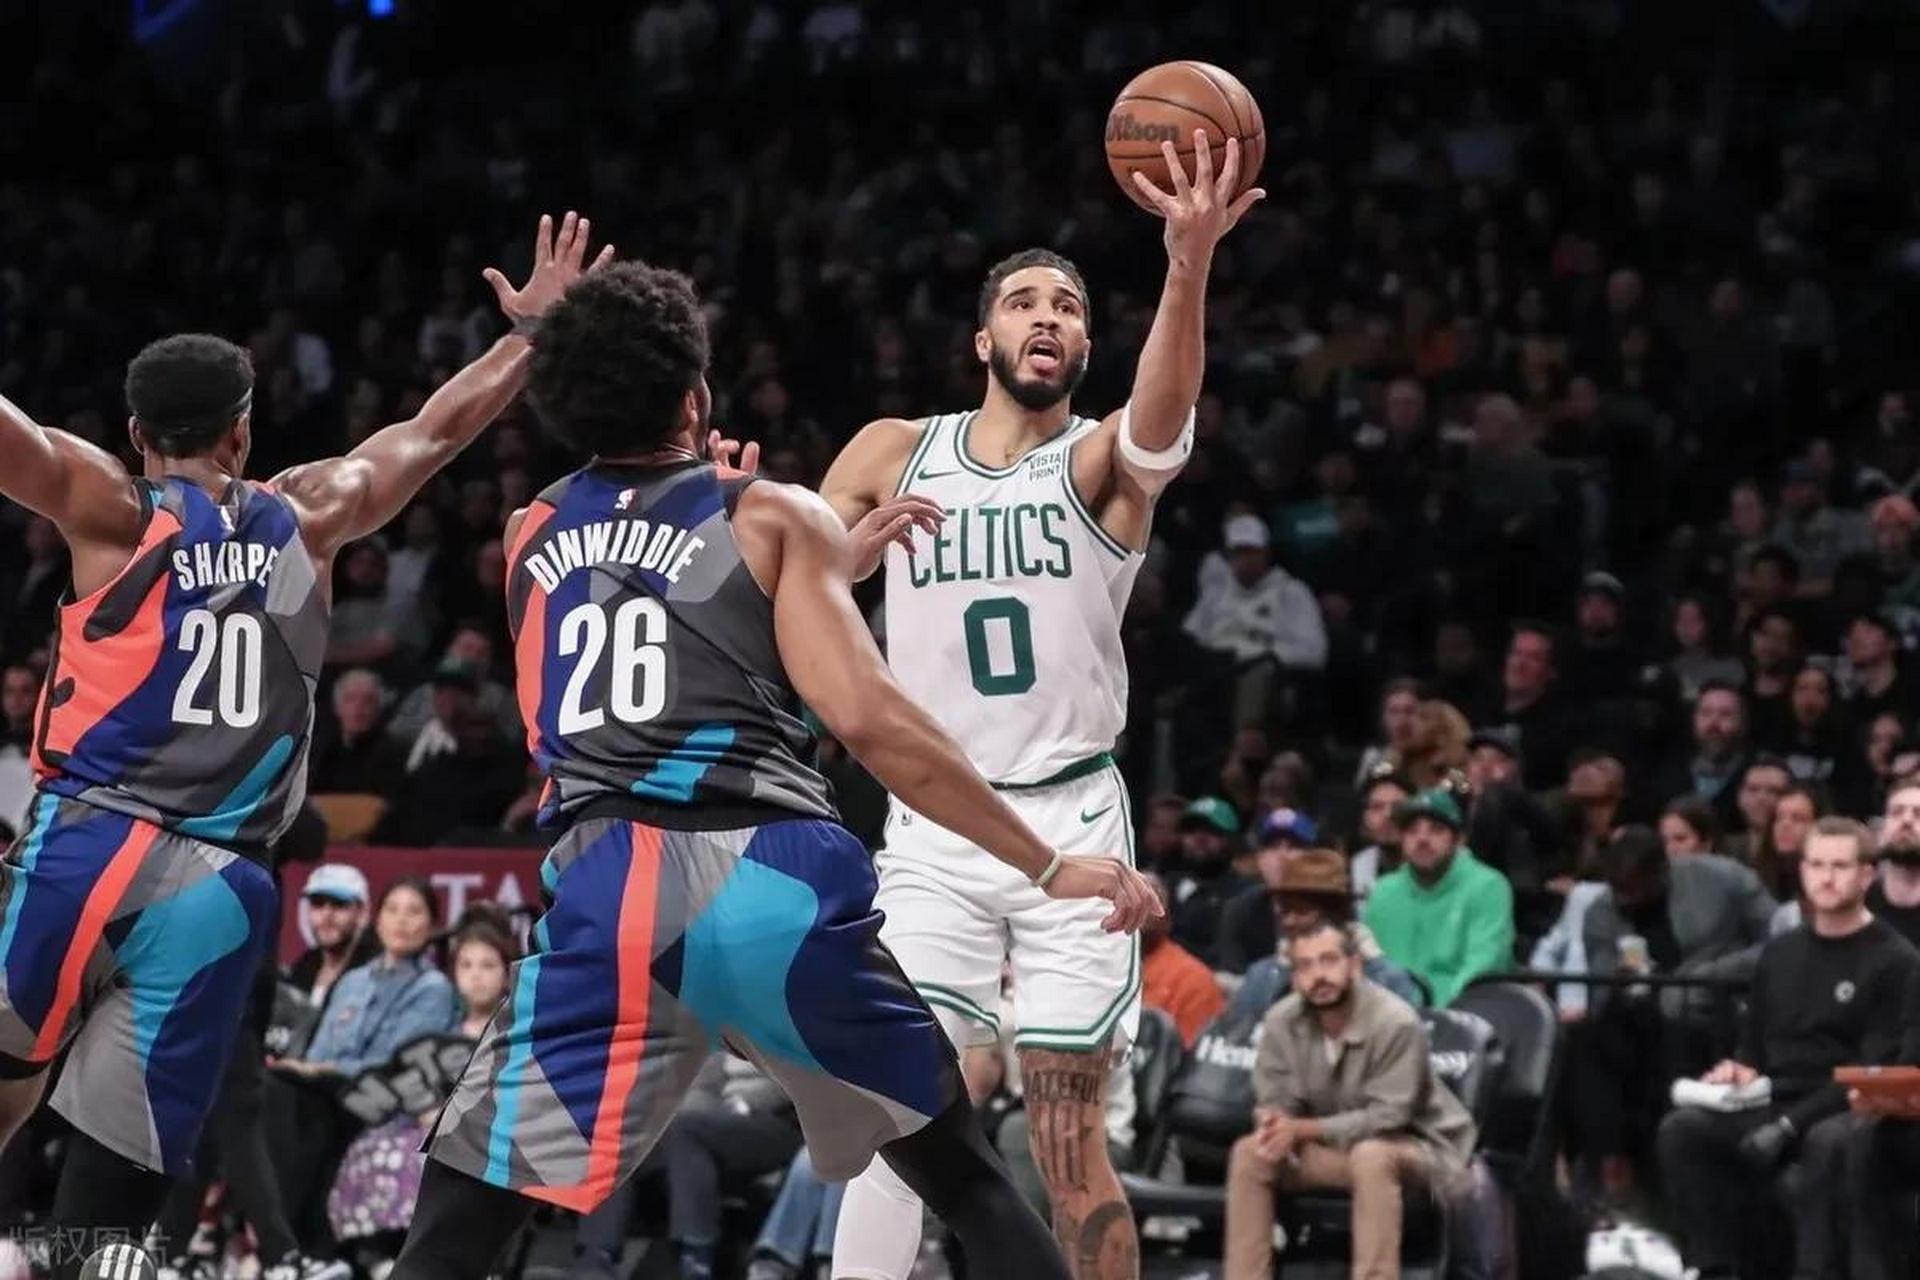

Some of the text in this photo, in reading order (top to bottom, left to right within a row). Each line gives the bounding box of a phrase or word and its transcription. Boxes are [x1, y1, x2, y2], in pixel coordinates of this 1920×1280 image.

[1030, 453, 1061, 470] VISTA
[1030, 464, 1060, 481] PRINT
[172, 541, 279, 591] SHARPE
[525, 520, 705, 595] DINWIDDIE
[171, 609, 262, 728] 20
[558, 597, 667, 735] 26
[963, 596, 1037, 696] 0
